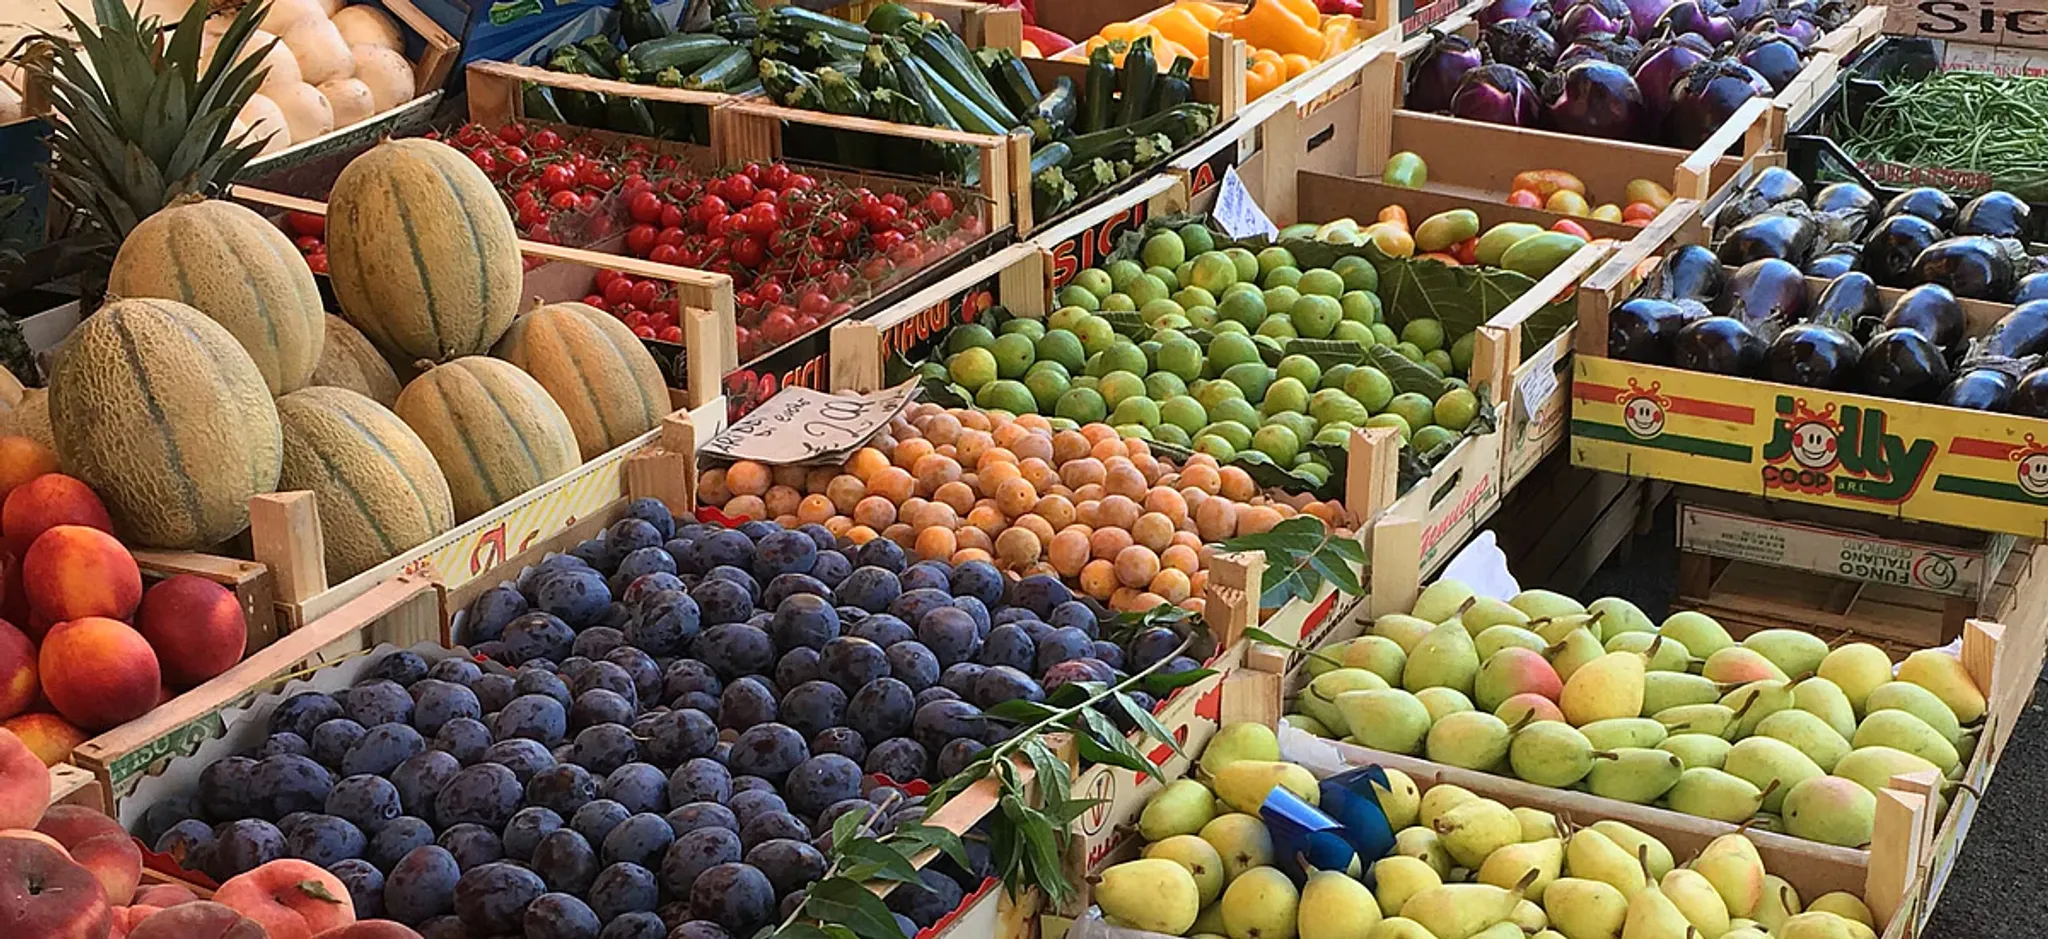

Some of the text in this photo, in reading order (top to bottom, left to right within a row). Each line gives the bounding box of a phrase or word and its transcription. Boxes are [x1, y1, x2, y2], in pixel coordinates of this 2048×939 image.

[1762, 465, 1832, 494] COOP
[1839, 561, 1910, 586] FUNGO
[1840, 550, 1913, 572] ITALIANO
